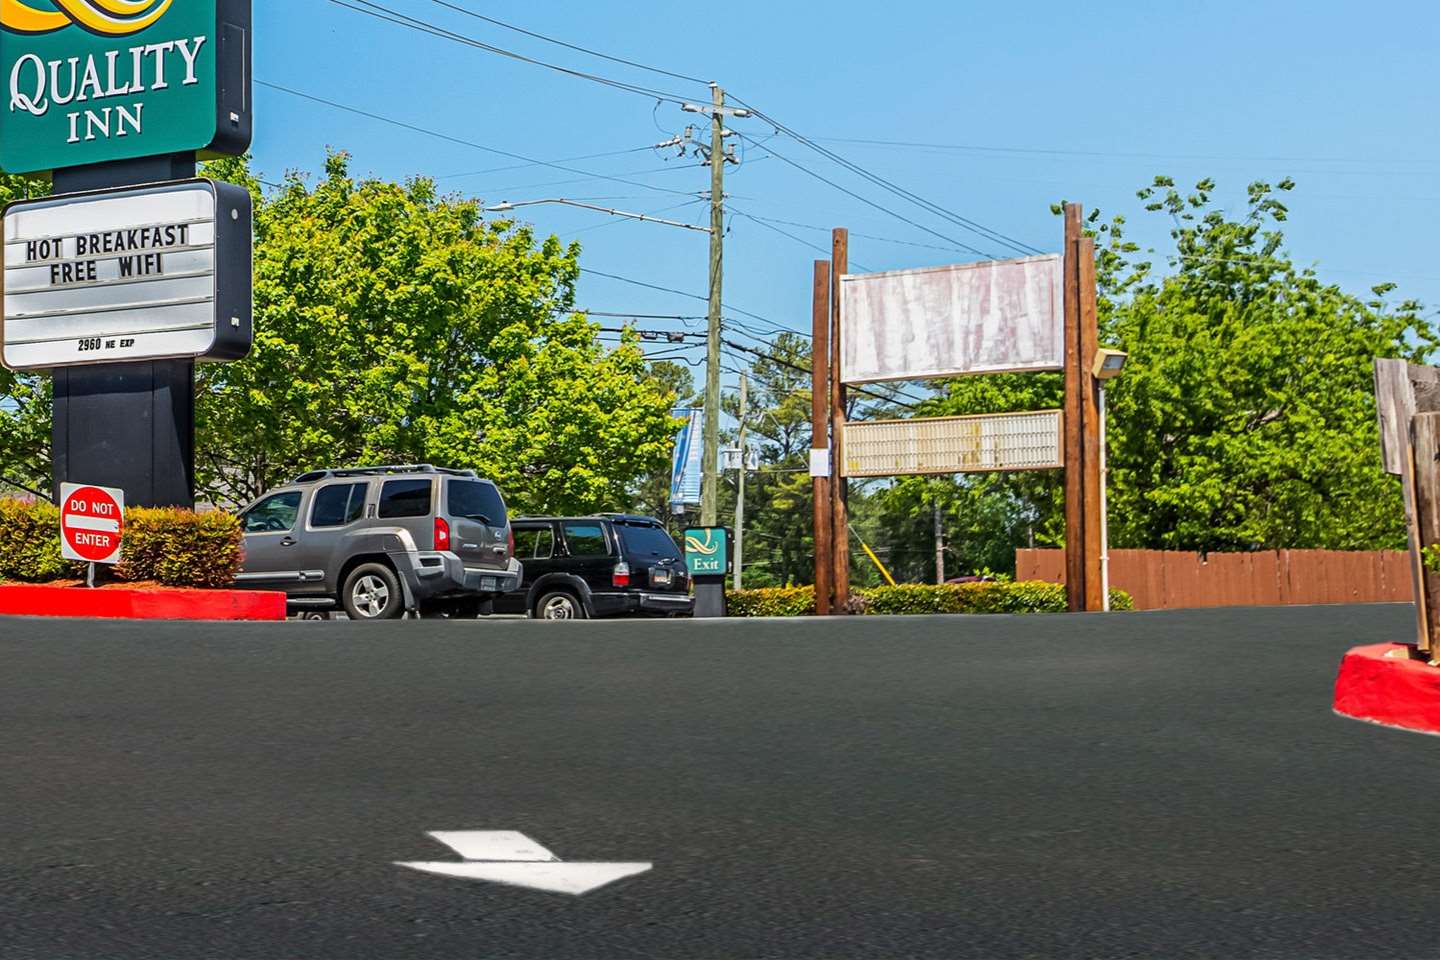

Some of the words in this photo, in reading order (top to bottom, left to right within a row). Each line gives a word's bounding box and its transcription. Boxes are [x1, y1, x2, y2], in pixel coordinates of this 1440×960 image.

[9, 36, 207, 116] QUALITY
[66, 103, 144, 144] INN
[26, 237, 62, 261] HOT
[76, 224, 189, 256] BREAKFAST
[50, 260, 97, 285] FREE
[118, 252, 163, 278] WIFI
[78, 338, 101, 351] 2960
[120, 339, 135, 348] EXP
[71, 499, 87, 513] DO
[92, 502, 114, 516] NOT
[75, 532, 110, 548] ENTER
[693, 557, 719, 571] Exit
